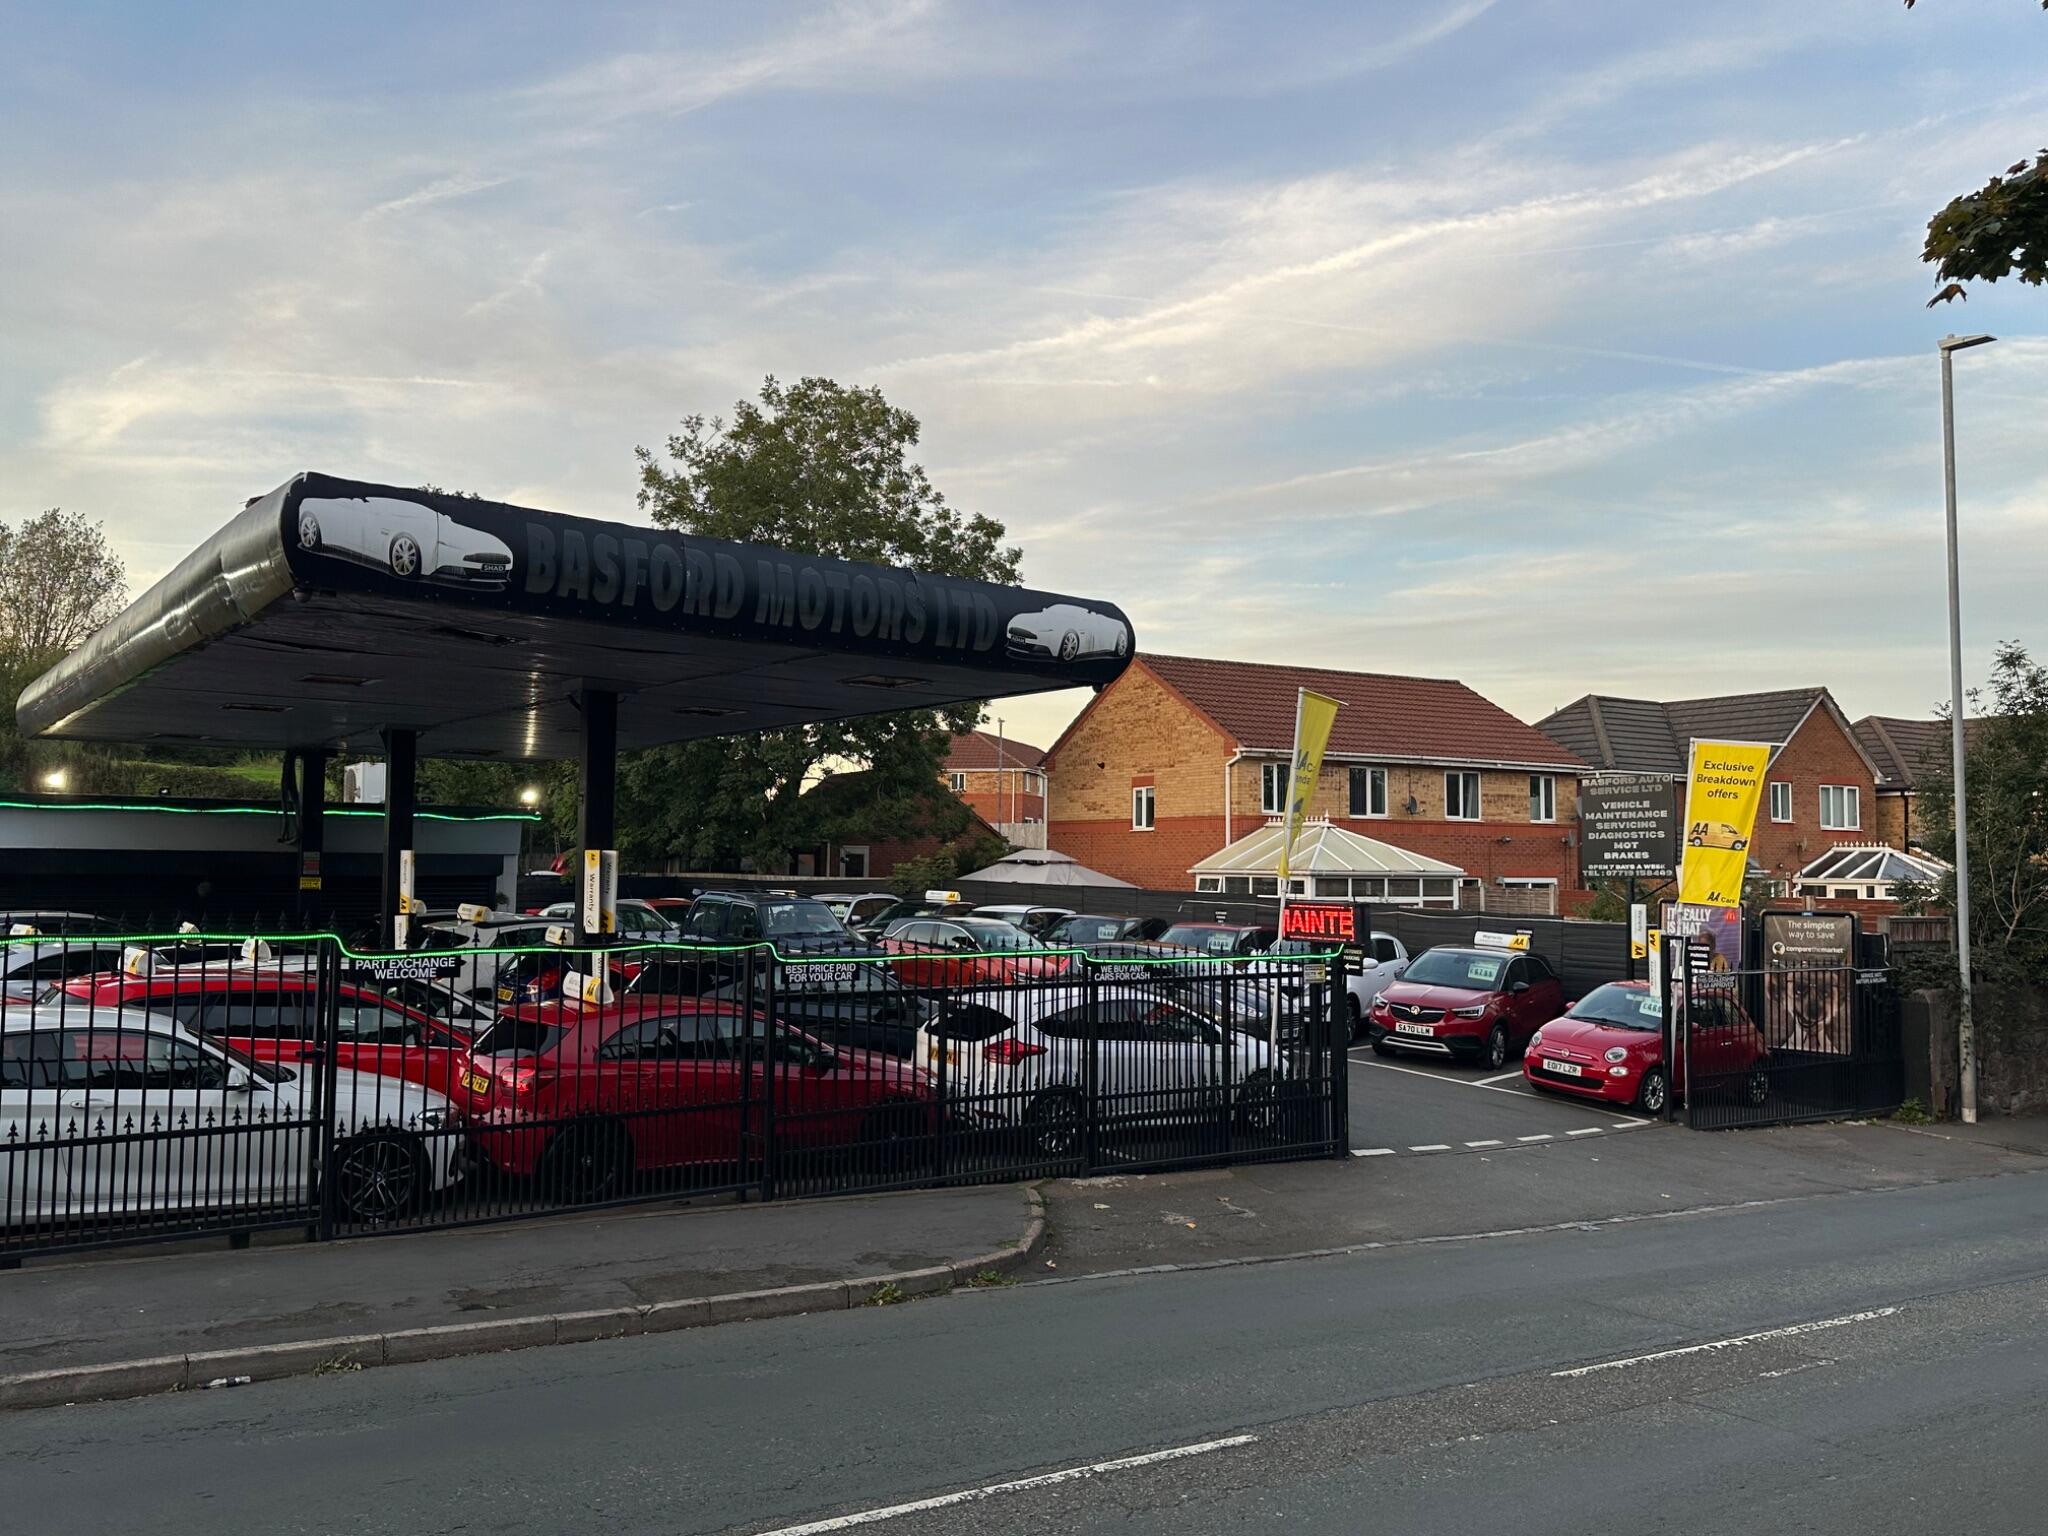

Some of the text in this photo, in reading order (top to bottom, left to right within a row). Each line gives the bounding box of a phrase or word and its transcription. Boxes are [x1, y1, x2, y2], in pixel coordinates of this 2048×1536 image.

[484, 564, 504, 572] SHAD
[525, 522, 999, 650] BASFORD MOTORS LTD
[1703, 760, 1754, 772] Exclusive
[1582, 775, 1670, 787] BASFORD AUTO
[1696, 774, 1756, 787] Breakdown
[1590, 784, 1663, 795] SERVICE LTD
[1707, 789, 1738, 799] offers
[1601, 801, 1650, 809] VEHICLE
[1585, 810, 1668, 820] MAINTENANCE
[1596, 821, 1657, 830] SERVICING
[1691, 822, 1709, 836] AA
[1588, 831, 1665, 839] DIAGNOSTICS
[587, 873, 595, 912] Warranty
[1707, 892, 1720, 902] AA
[1682, 908, 1711, 922] EALLY
[1682, 922, 1701, 935] HAT
[1788, 920, 1835, 931] The simples
[1788, 931, 1804, 940] way
[1806, 931, 1815, 939] to
[1514, 938, 1524, 946] AA
[1634, 945, 1643, 956] AA
[355, 957, 456, 970] PART EXCHANGE
[785, 963, 856, 974] BEST PRICE PAID
[1101, 964, 1145, 973] WE BUY ANY
[374, 968, 437, 979] WELCOME
[789, 972, 852, 982] FOR YOUR CAR
[1094, 971, 1151, 981] CARS FOR CASH
[1398, 1024, 1430, 1034] SA70 LLM
[1563, 1064, 1578, 1073] LZR
